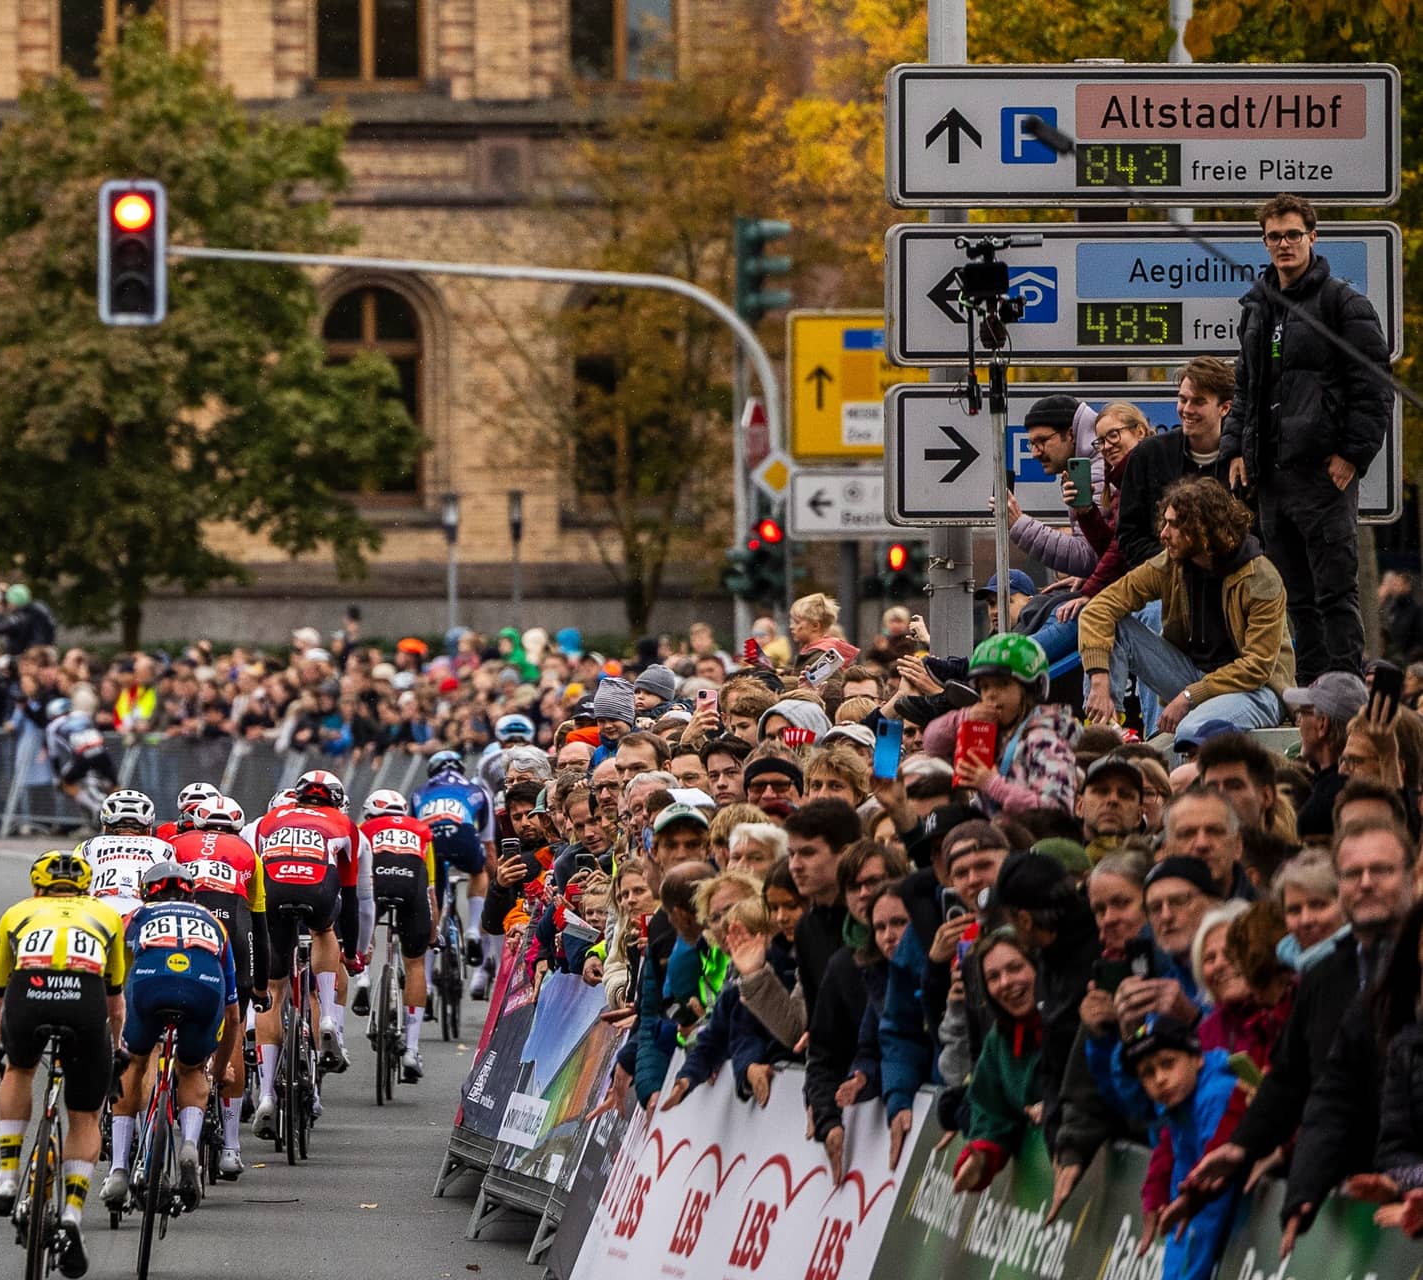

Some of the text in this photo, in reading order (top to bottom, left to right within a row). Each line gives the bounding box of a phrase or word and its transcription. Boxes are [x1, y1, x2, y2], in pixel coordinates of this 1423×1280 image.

[1100, 95, 1342, 129] Altstadt/Hbf
[1086, 145, 1167, 184] 843
[1192, 160, 1333, 181] freie Plätze
[1129, 257, 1270, 289] Aegidiima
[1086, 305, 1168, 344] 485
[294, 829, 323, 848] 132
[375, 830, 395, 845] 34
[399, 830, 418, 847] 34
[209, 861, 232, 880] 35
[279, 864, 314, 876] CAPS
[375, 866, 415, 878] Cofidis
[145, 917, 171, 939] 26
[25, 929, 54, 953] 87
[47, 975, 82, 988] VISMA
[668, 1187, 711, 1259] LBS
[728, 1198, 779, 1272] LBS
[803, 1215, 853, 1280] LBS
